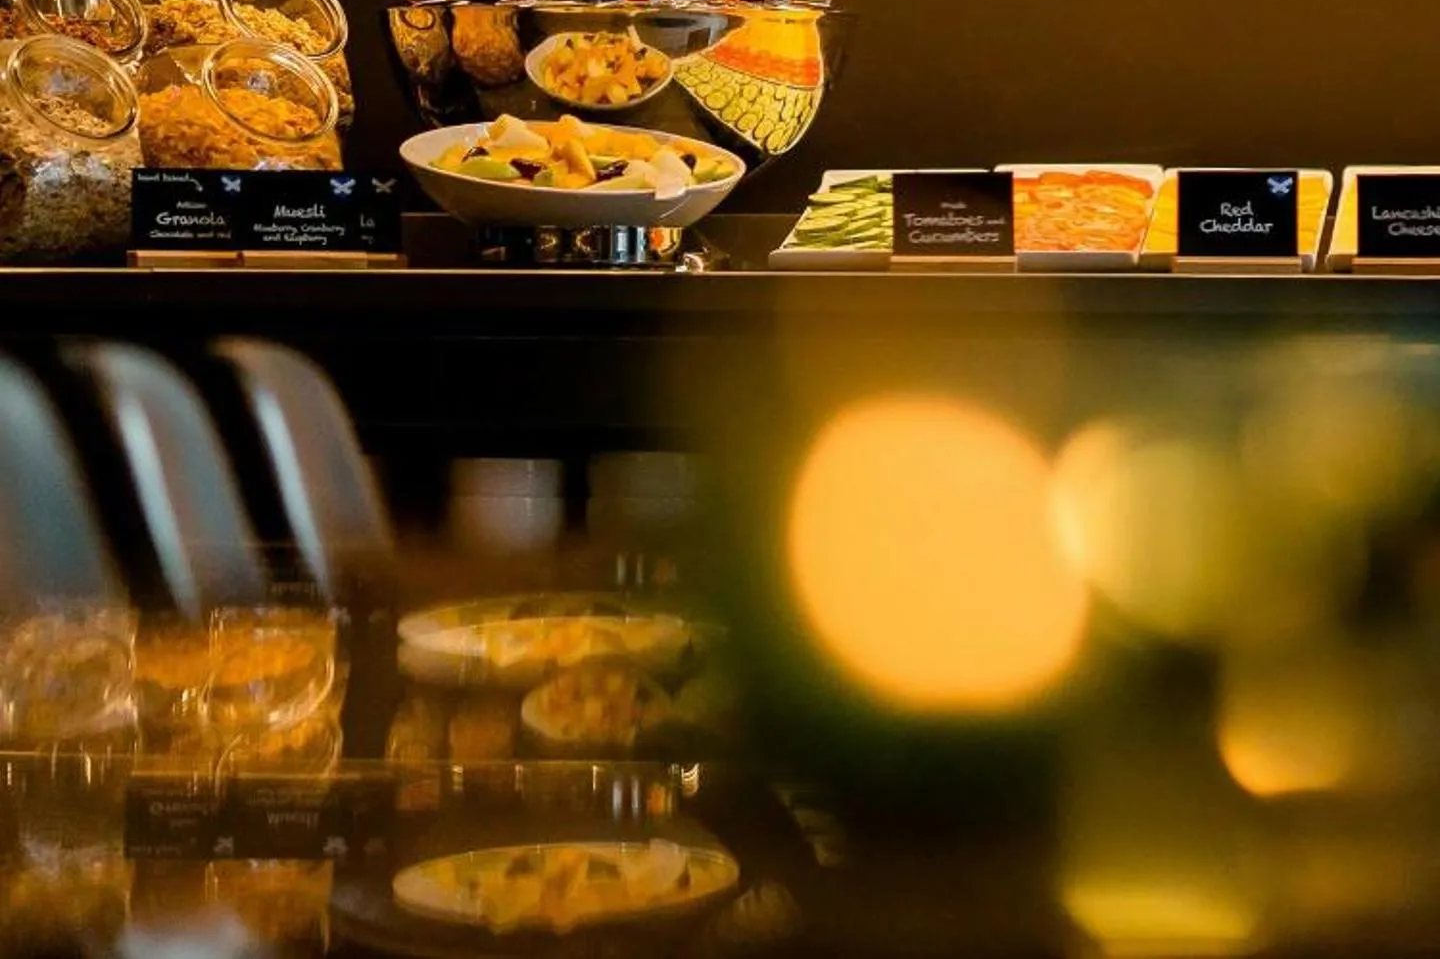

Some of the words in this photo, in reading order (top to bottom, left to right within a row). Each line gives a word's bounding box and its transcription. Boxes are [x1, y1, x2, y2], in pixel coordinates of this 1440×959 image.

[155, 210, 227, 226] Granola
[273, 203, 327, 220] Muesli
[1220, 201, 1255, 218] Red
[1199, 217, 1275, 235] Cheddar
